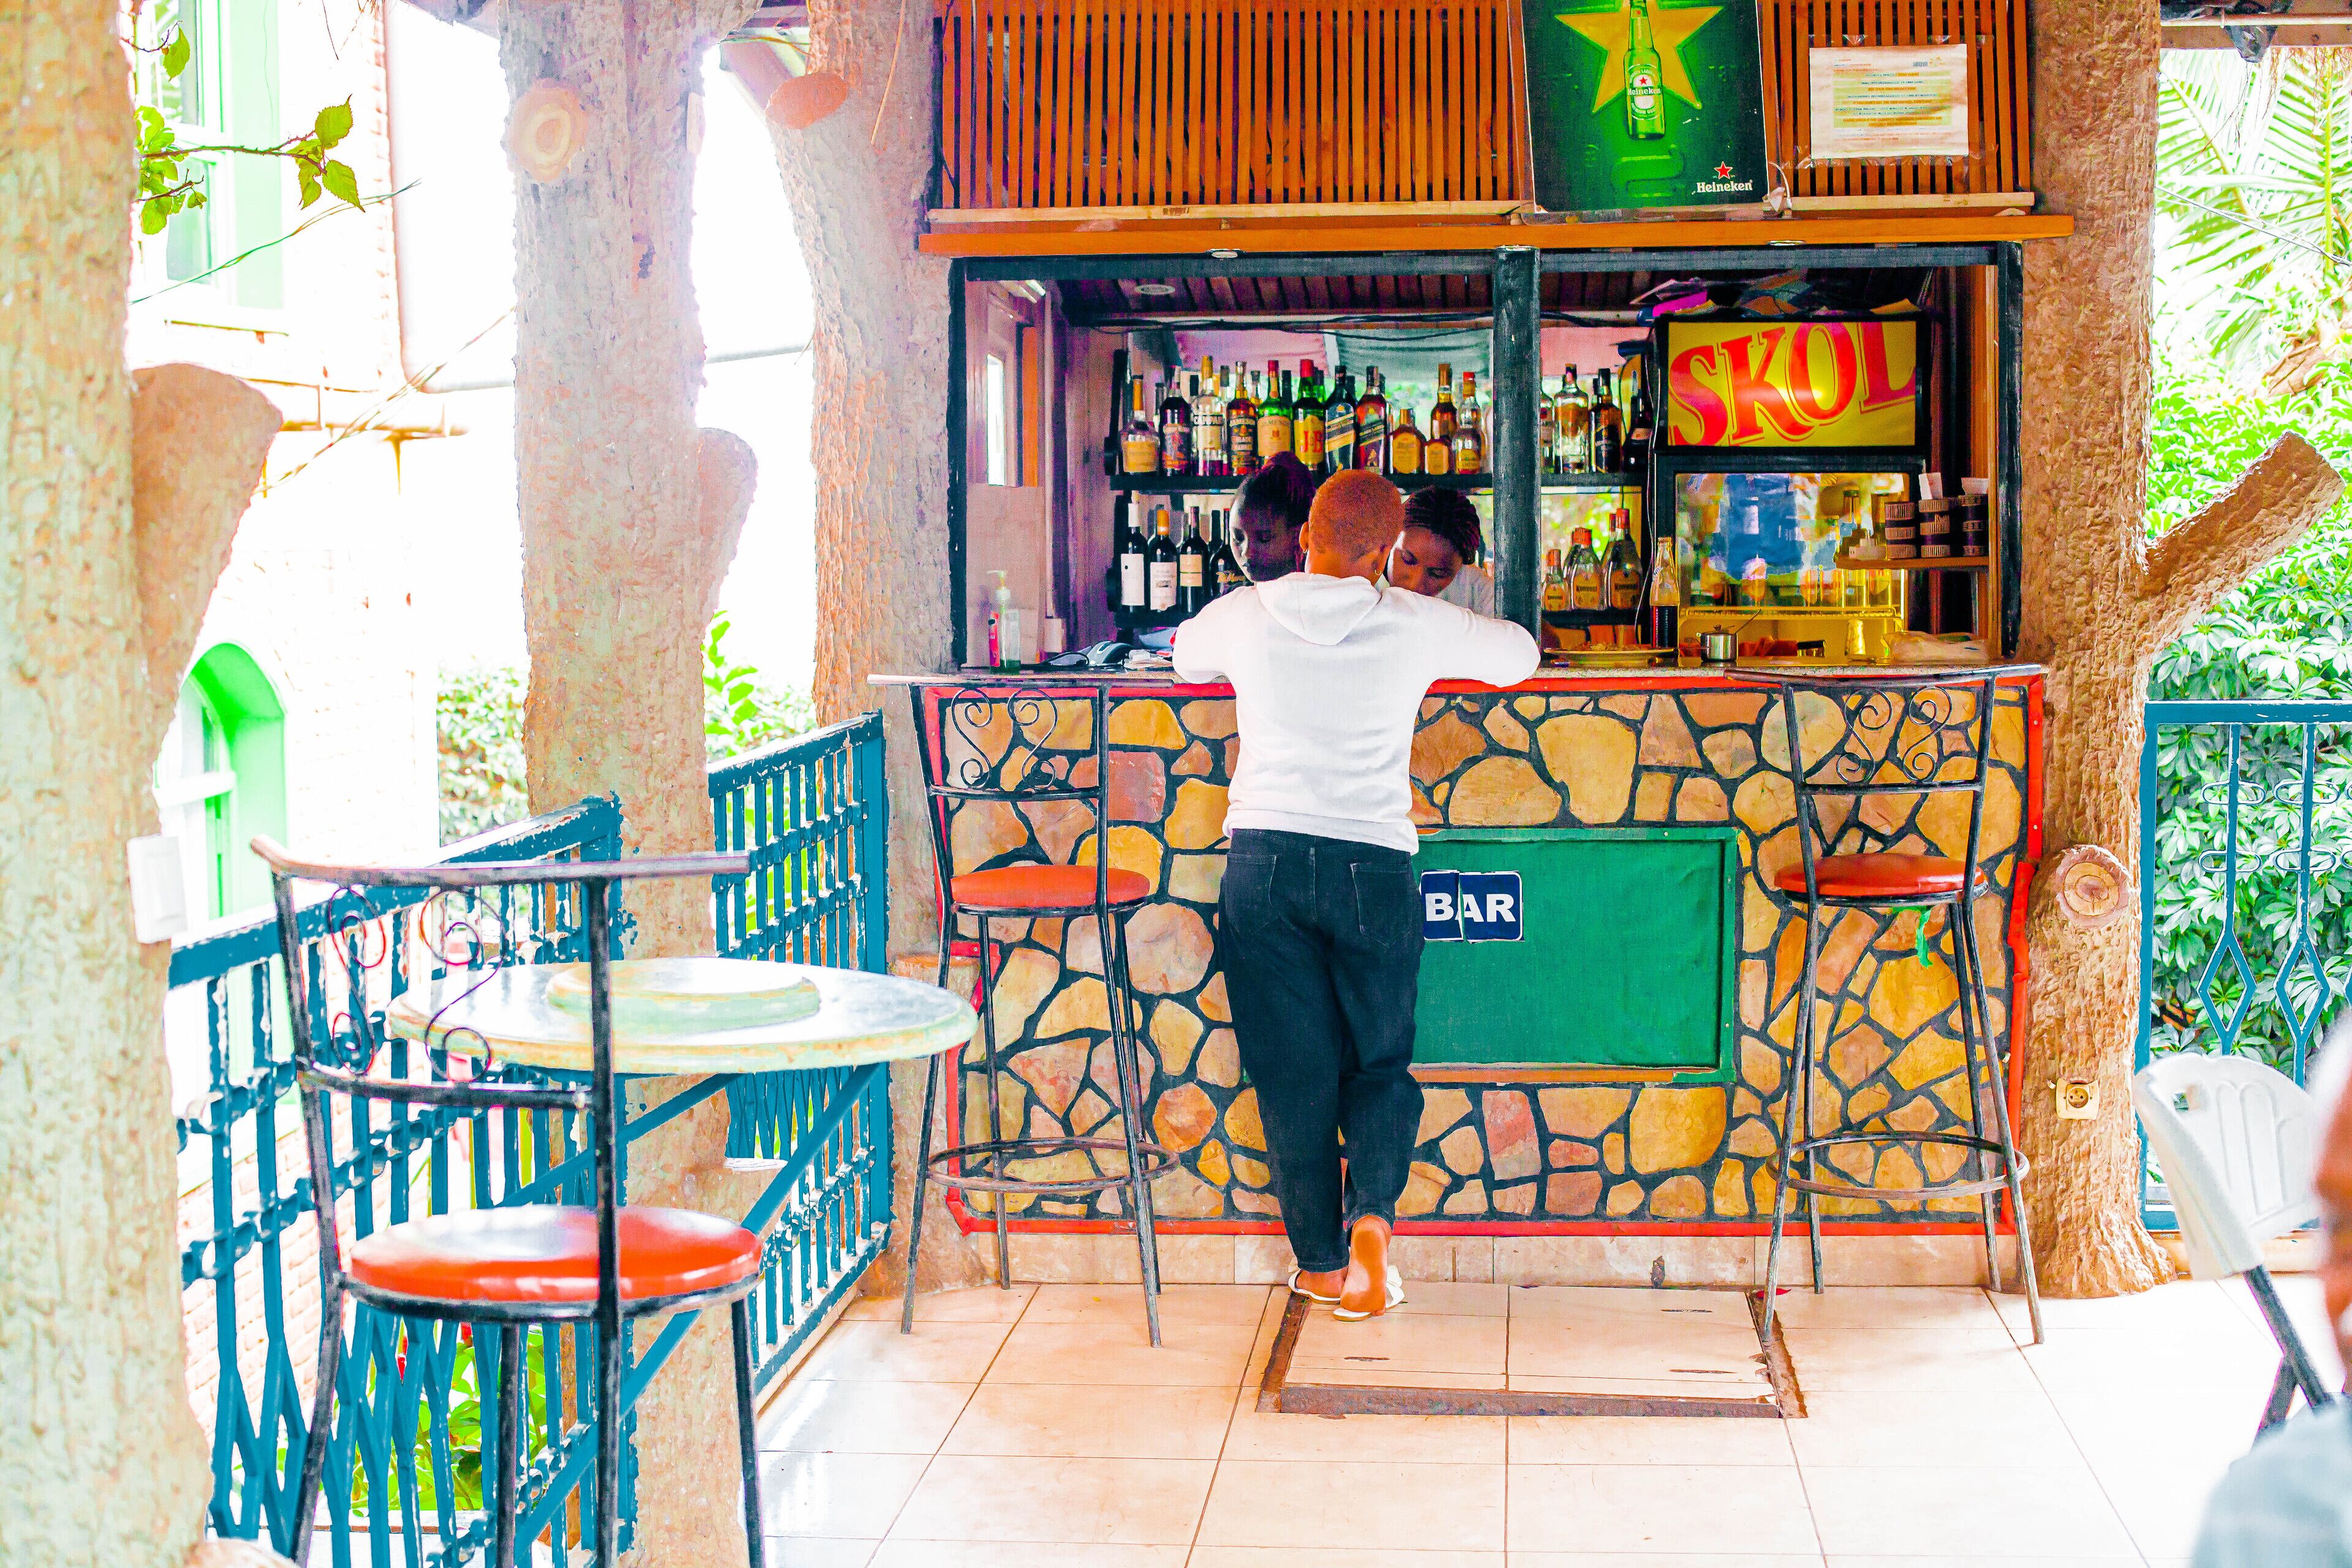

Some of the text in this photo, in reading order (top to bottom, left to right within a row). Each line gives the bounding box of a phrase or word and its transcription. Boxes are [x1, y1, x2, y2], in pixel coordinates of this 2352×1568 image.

[1696, 181, 1752, 193] Heineken
[1668, 322, 1915, 446] SKOL
[1425, 892, 1517, 922] BAR
